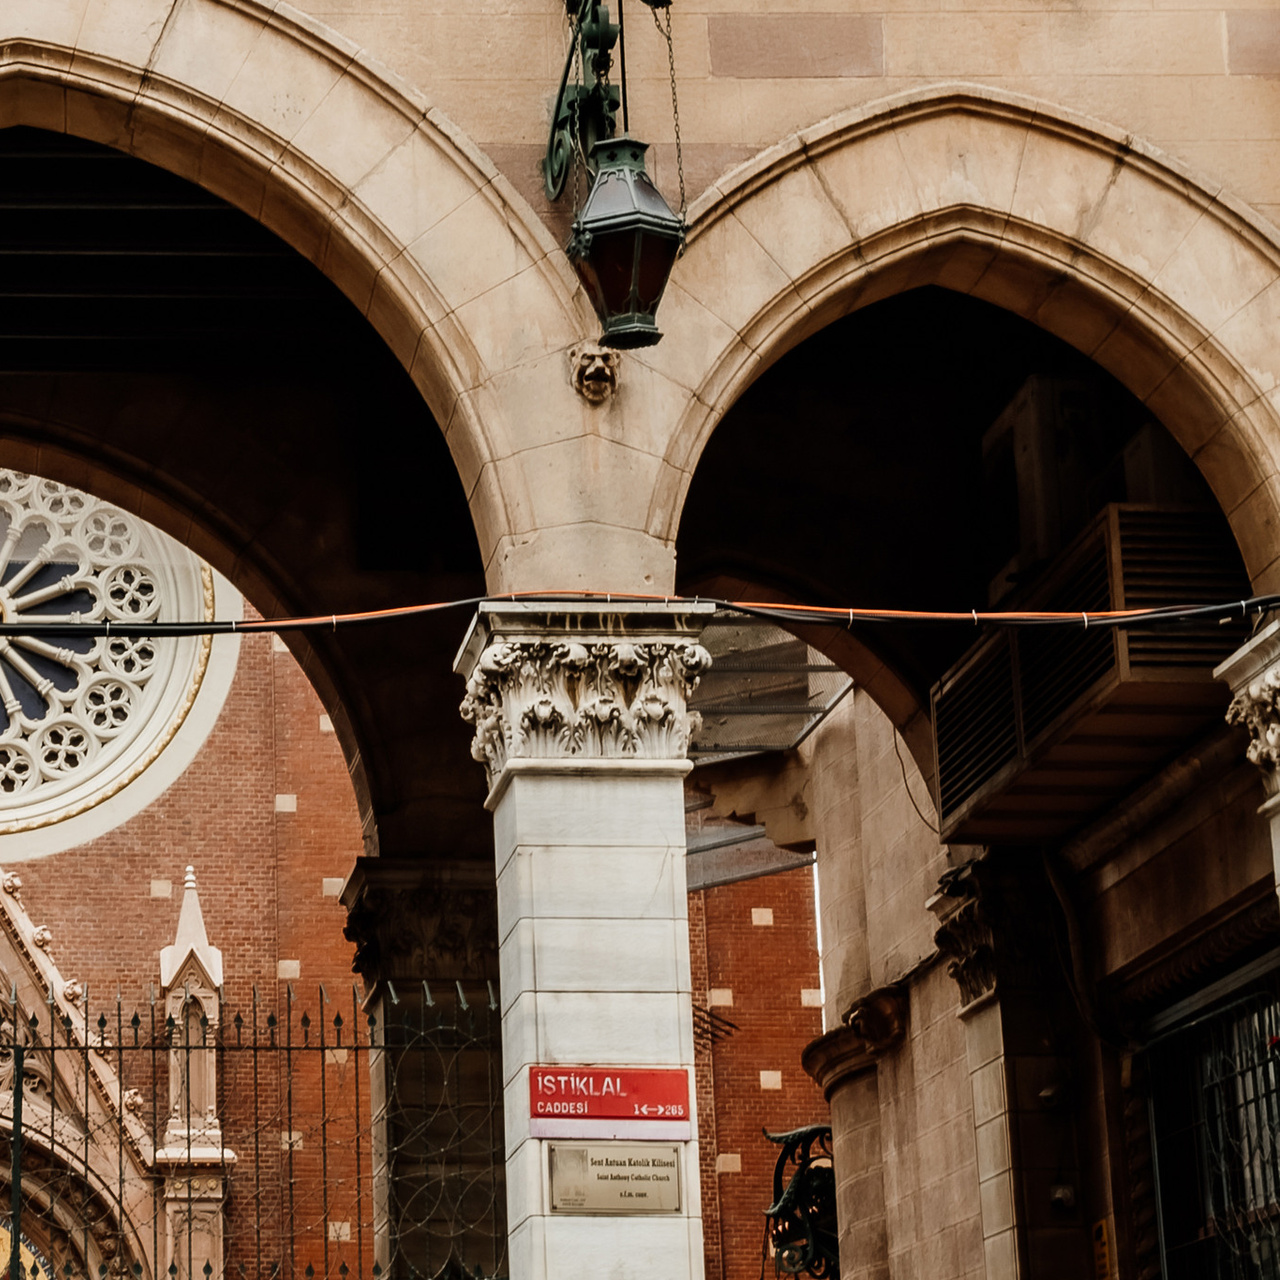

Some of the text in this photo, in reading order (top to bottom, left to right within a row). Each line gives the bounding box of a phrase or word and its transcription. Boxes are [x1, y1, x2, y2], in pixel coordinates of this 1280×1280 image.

[537, 1072, 628, 1096] İSTİKLAL
[537, 1101, 588, 1113] CADDESİ
[605, 1158, 626, 1166] Antuan
[628, 1158, 650, 1167] Katolik
[652, 1159, 675, 1168] Kilisesi
